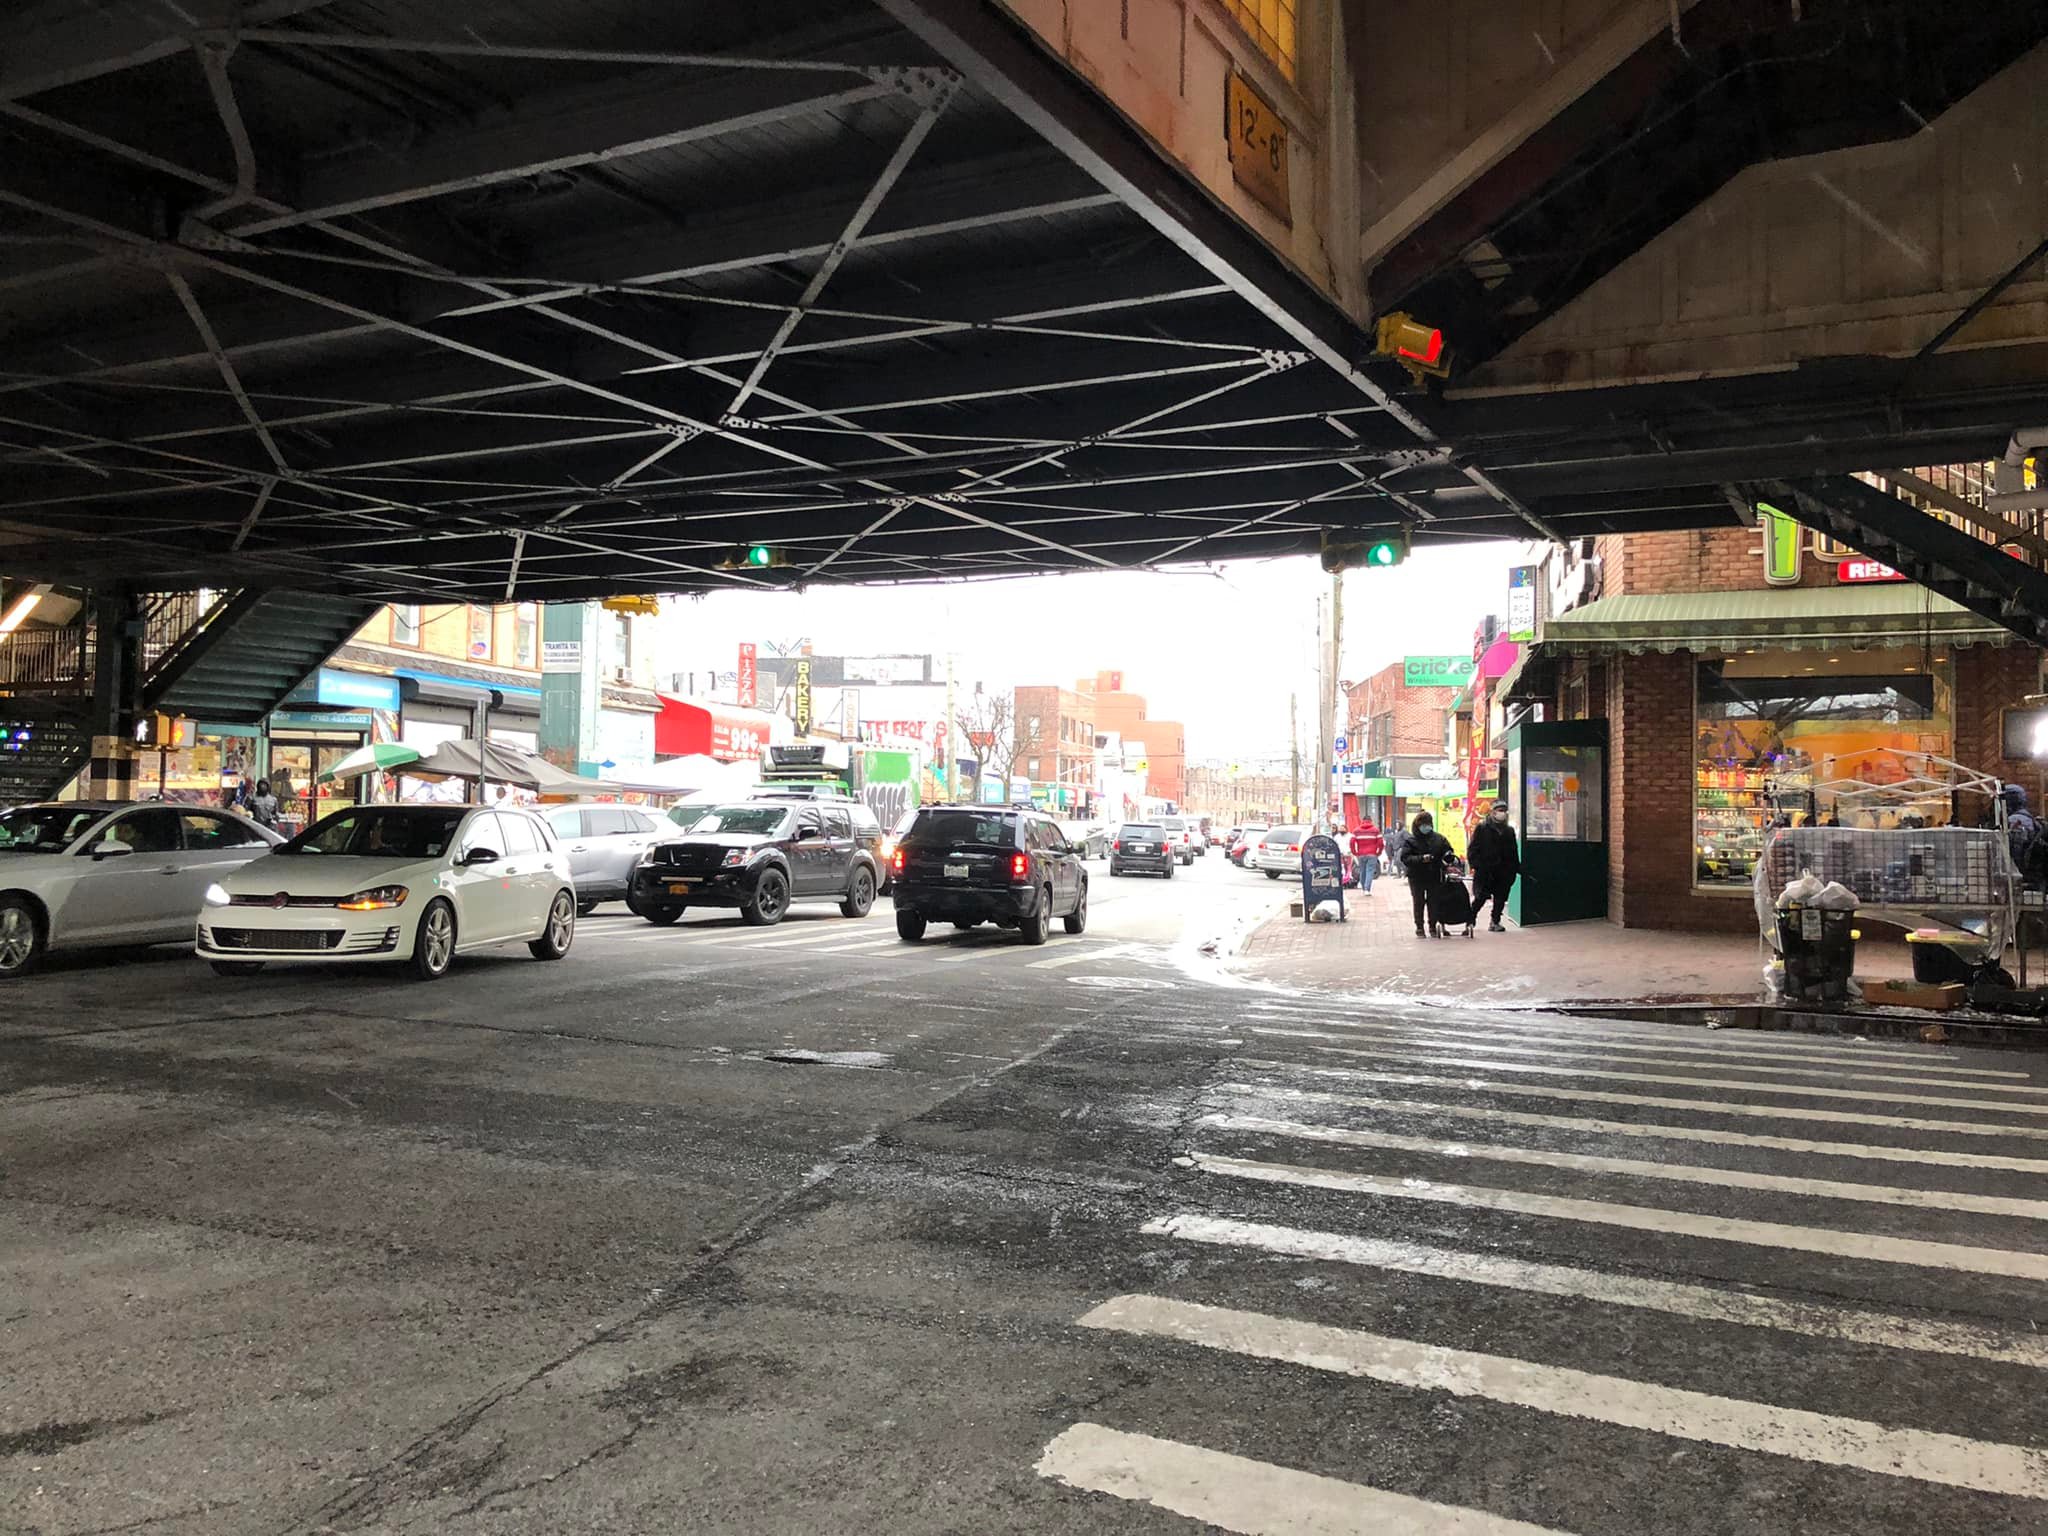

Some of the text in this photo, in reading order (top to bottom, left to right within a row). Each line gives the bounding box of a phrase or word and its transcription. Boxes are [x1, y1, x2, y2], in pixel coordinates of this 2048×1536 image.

[742, 645, 753, 705] PIZZA
[797, 661, 810, 732] BAKERY
[1407, 658, 1477, 675] cricke
